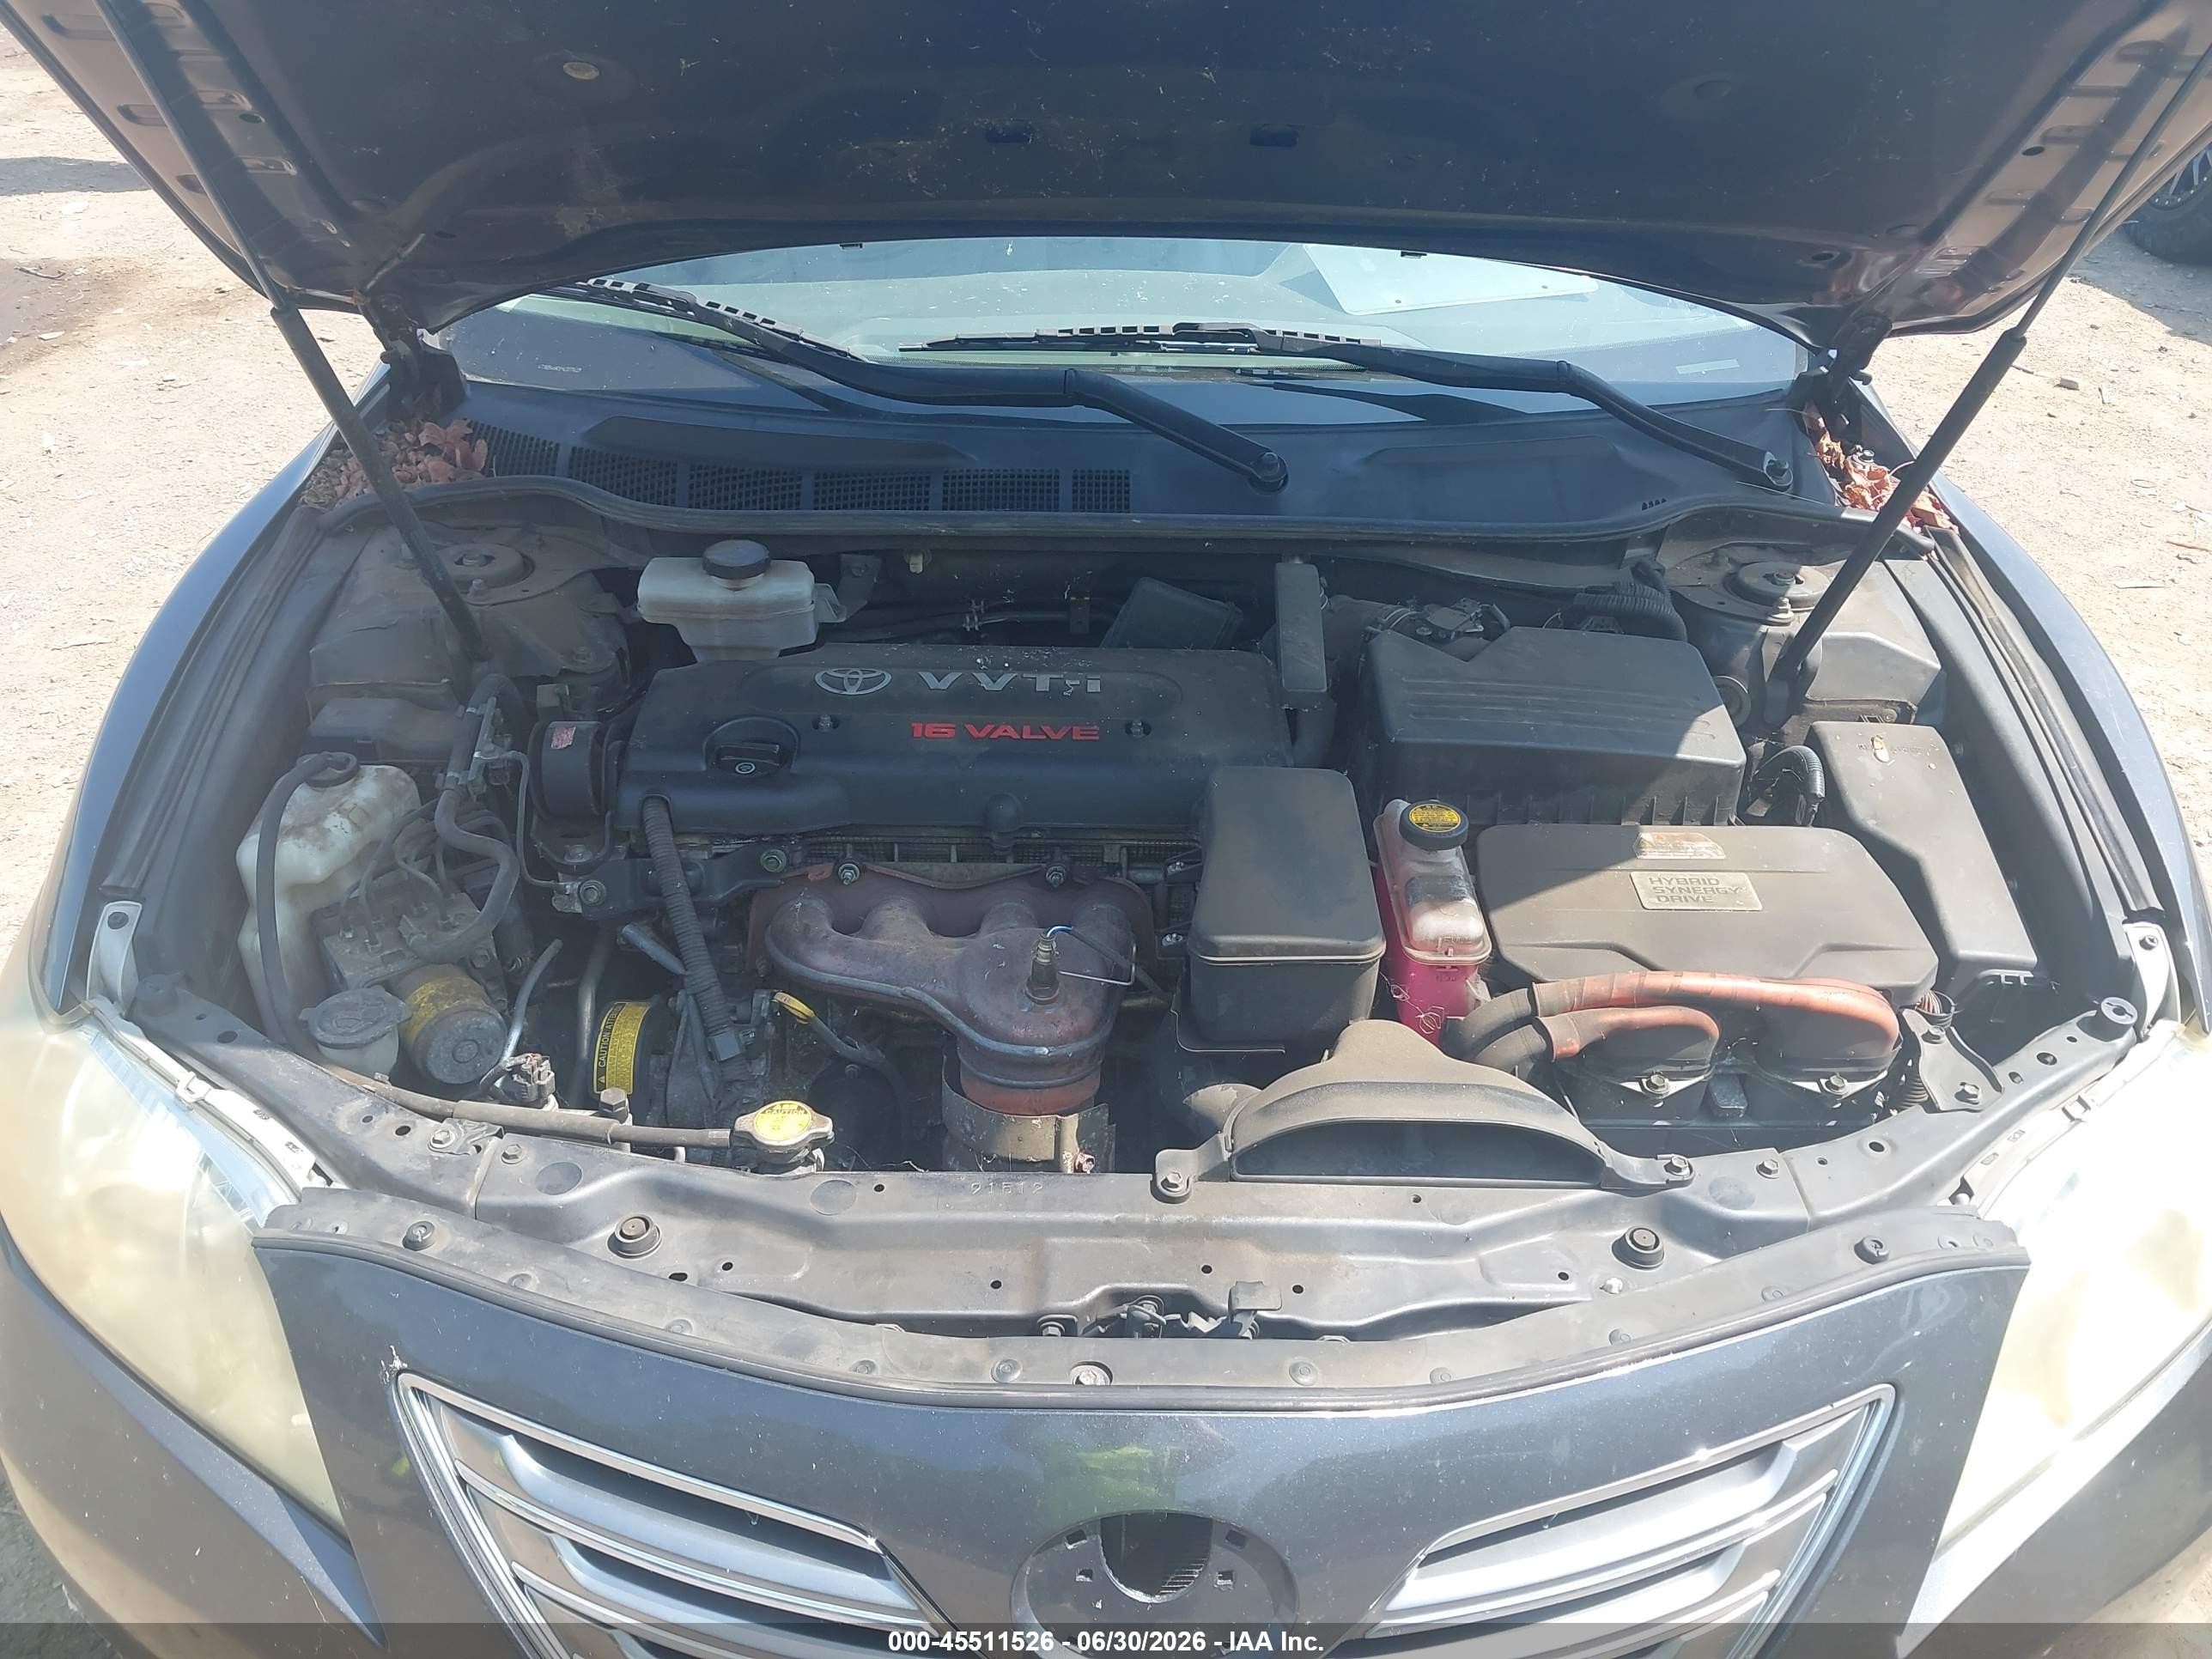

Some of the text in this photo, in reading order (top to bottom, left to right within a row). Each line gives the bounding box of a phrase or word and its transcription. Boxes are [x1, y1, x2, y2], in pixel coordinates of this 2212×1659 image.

[911, 723, 1100, 740] 16 VALVE
[1649, 877, 1720, 886] HYBRID
[1652, 886, 1739, 895] SYNERGY
[599, 1031, 611, 1067] CAUTION
